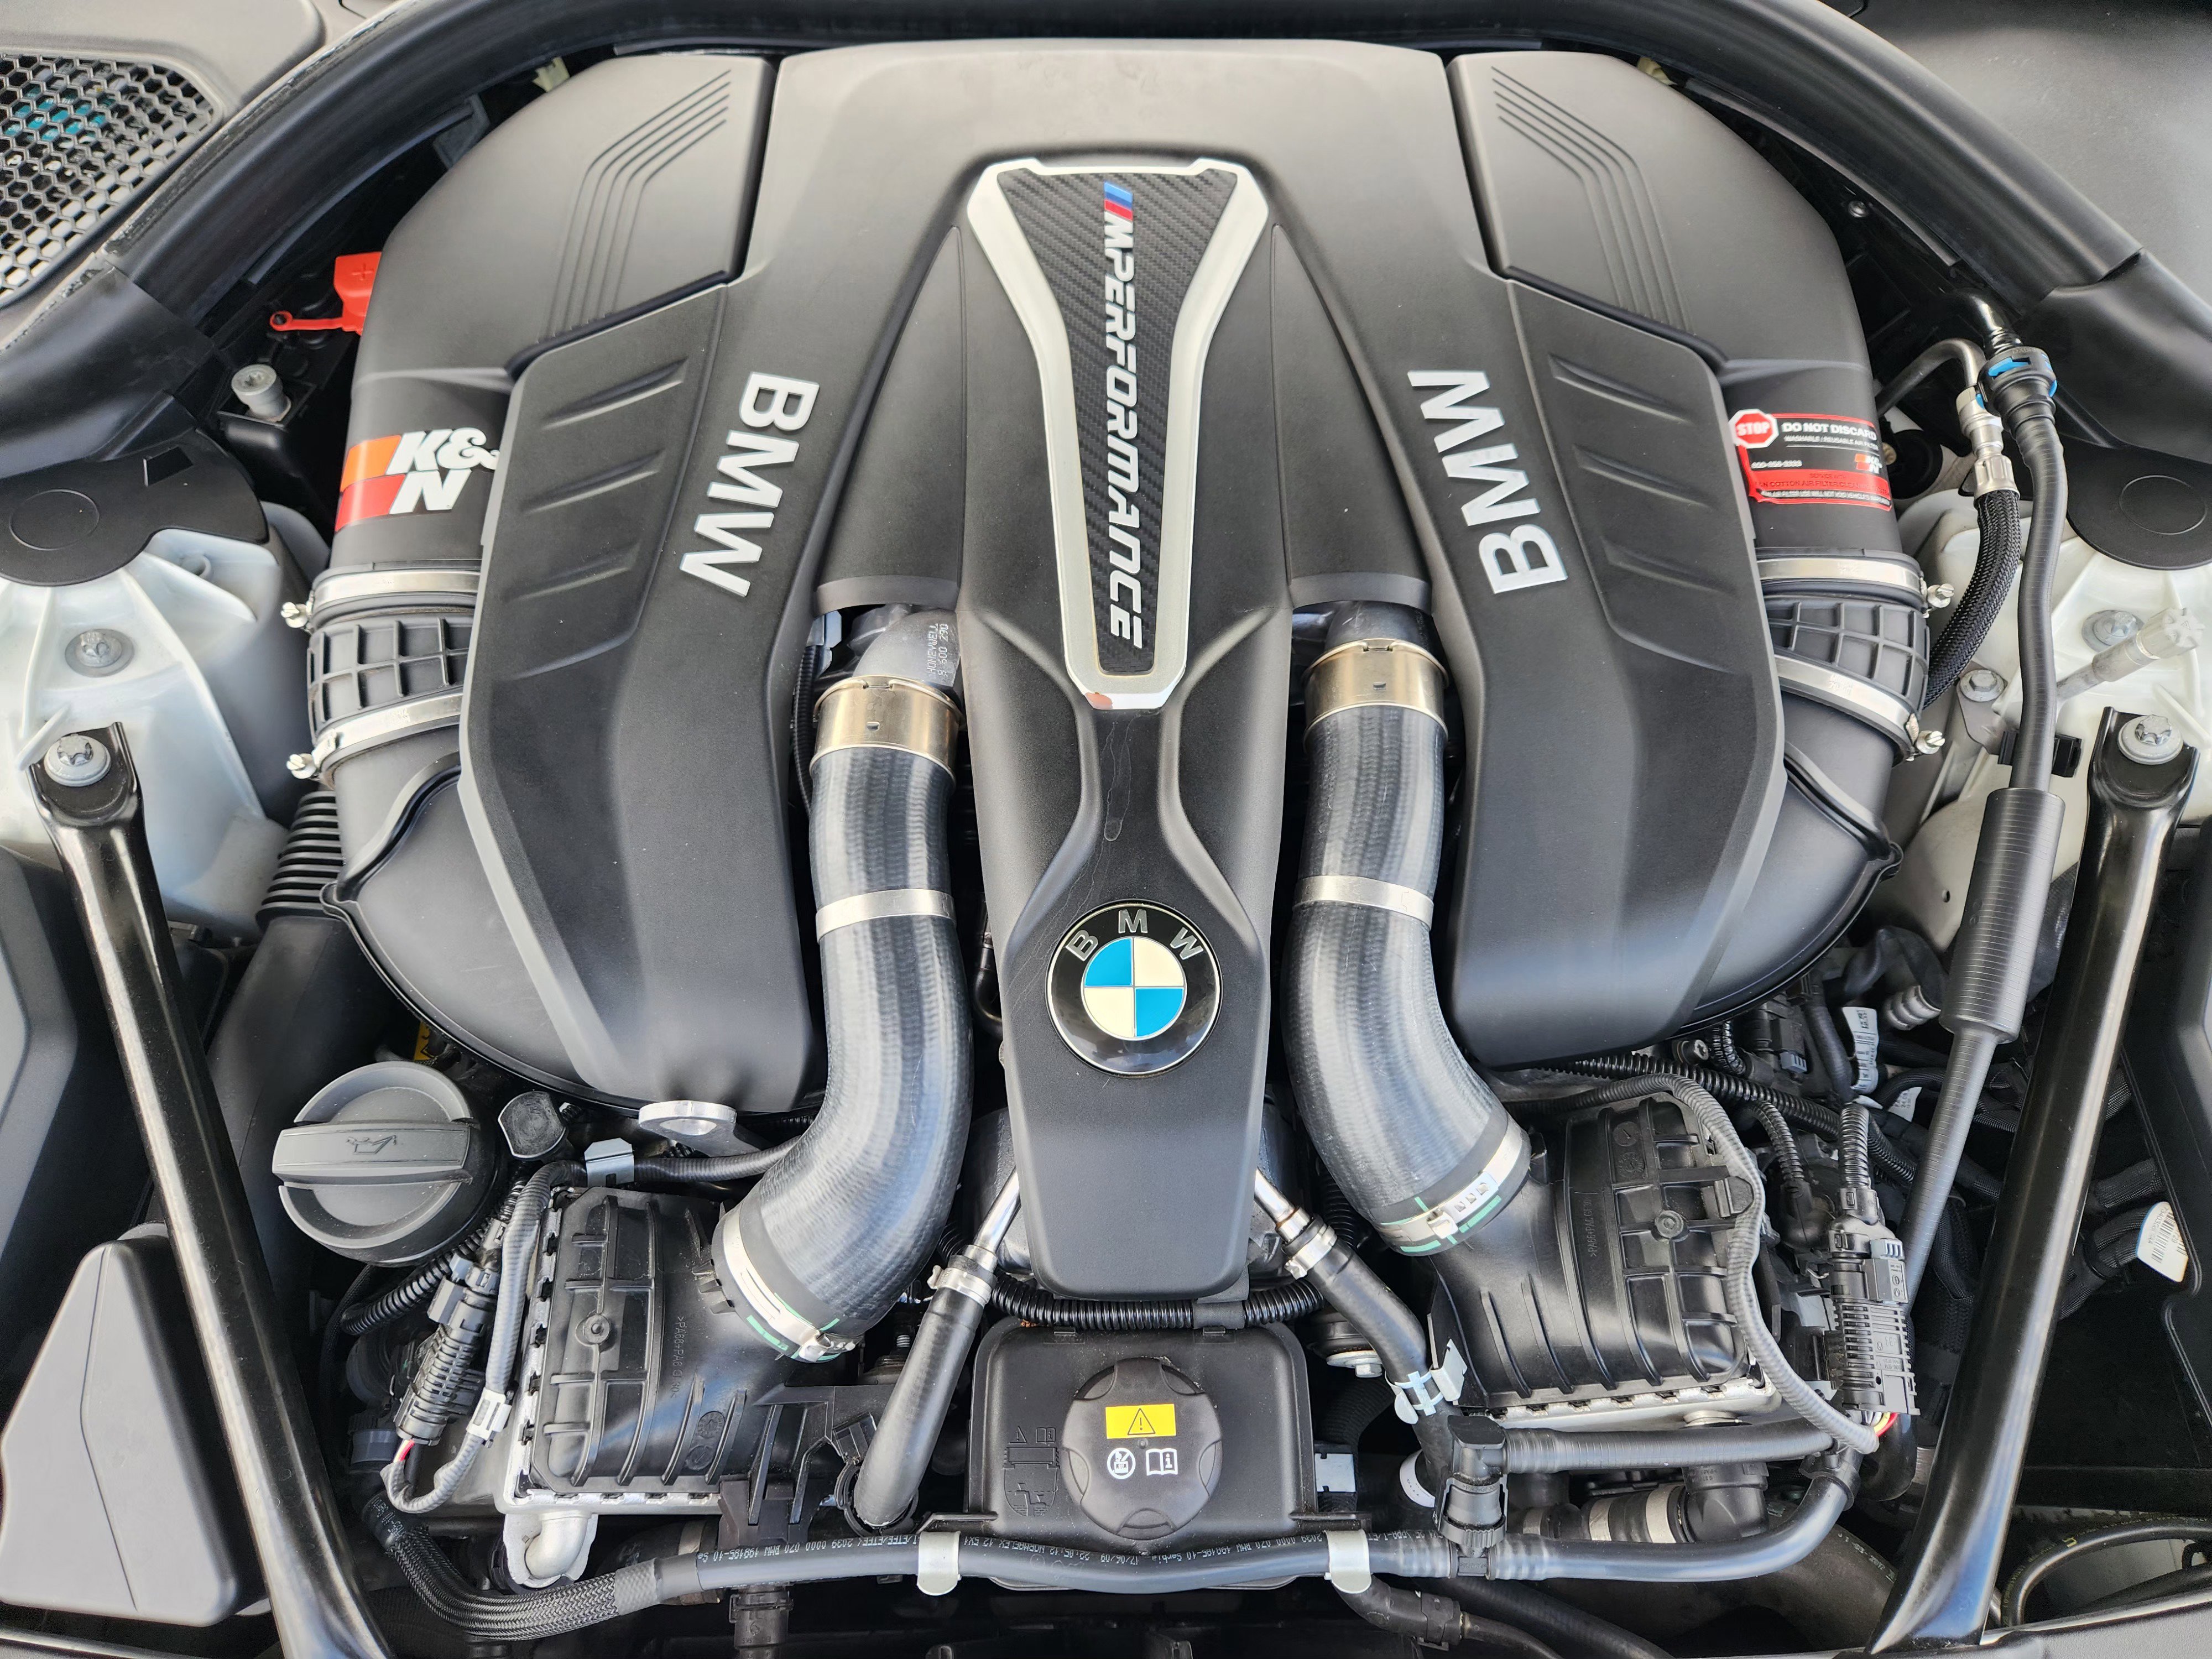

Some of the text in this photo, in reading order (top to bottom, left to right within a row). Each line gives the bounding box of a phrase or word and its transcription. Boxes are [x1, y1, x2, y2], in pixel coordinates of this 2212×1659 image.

[1736, 421, 1770, 436] STOP
[1781, 422, 1877, 441] DO NOT DISCARD
[679, 371, 820, 598] BMW
[1407, 370, 1568, 594] BMW
[927, 623, 938, 675] HONEYWELL
[1065, 909, 1204, 961] BMW
[763, 1543, 780, 1557] BMW
[783, 1542, 800, 1554] 070
[804, 1540, 827, 1552] 0000
[831, 1538, 853, 1550] 2039
[712, 1546, 760, 1562] 198185-10
[1151, 1552, 1182, 1564] Serbia
